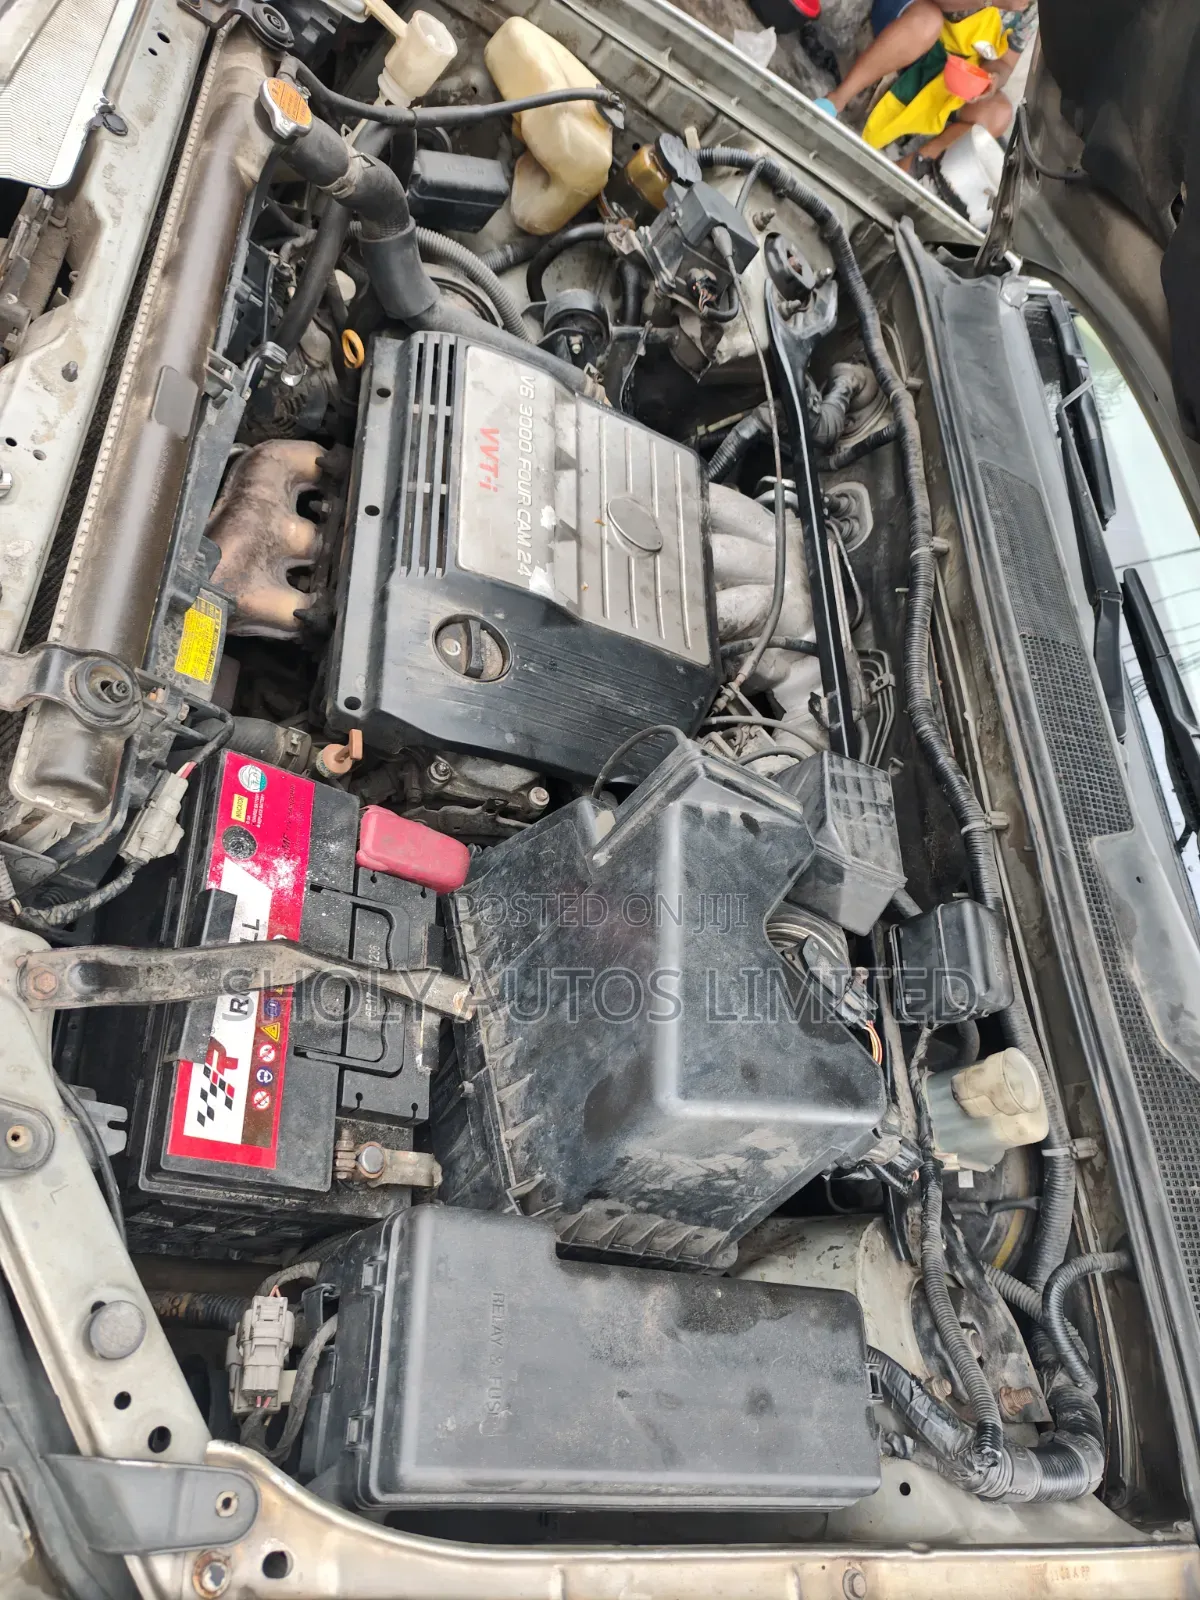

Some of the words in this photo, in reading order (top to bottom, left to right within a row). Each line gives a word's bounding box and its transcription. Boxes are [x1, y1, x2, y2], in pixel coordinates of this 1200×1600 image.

[519, 374, 536, 398] V6
[518, 404, 534, 453] 3000
[478, 427, 500, 492] VVT-i
[517, 457, 533, 505] FOUR
[516, 508, 532, 547] CAM
[490, 1292, 505, 1348] RELAY
[486, 1375, 503, 1422] FUS
